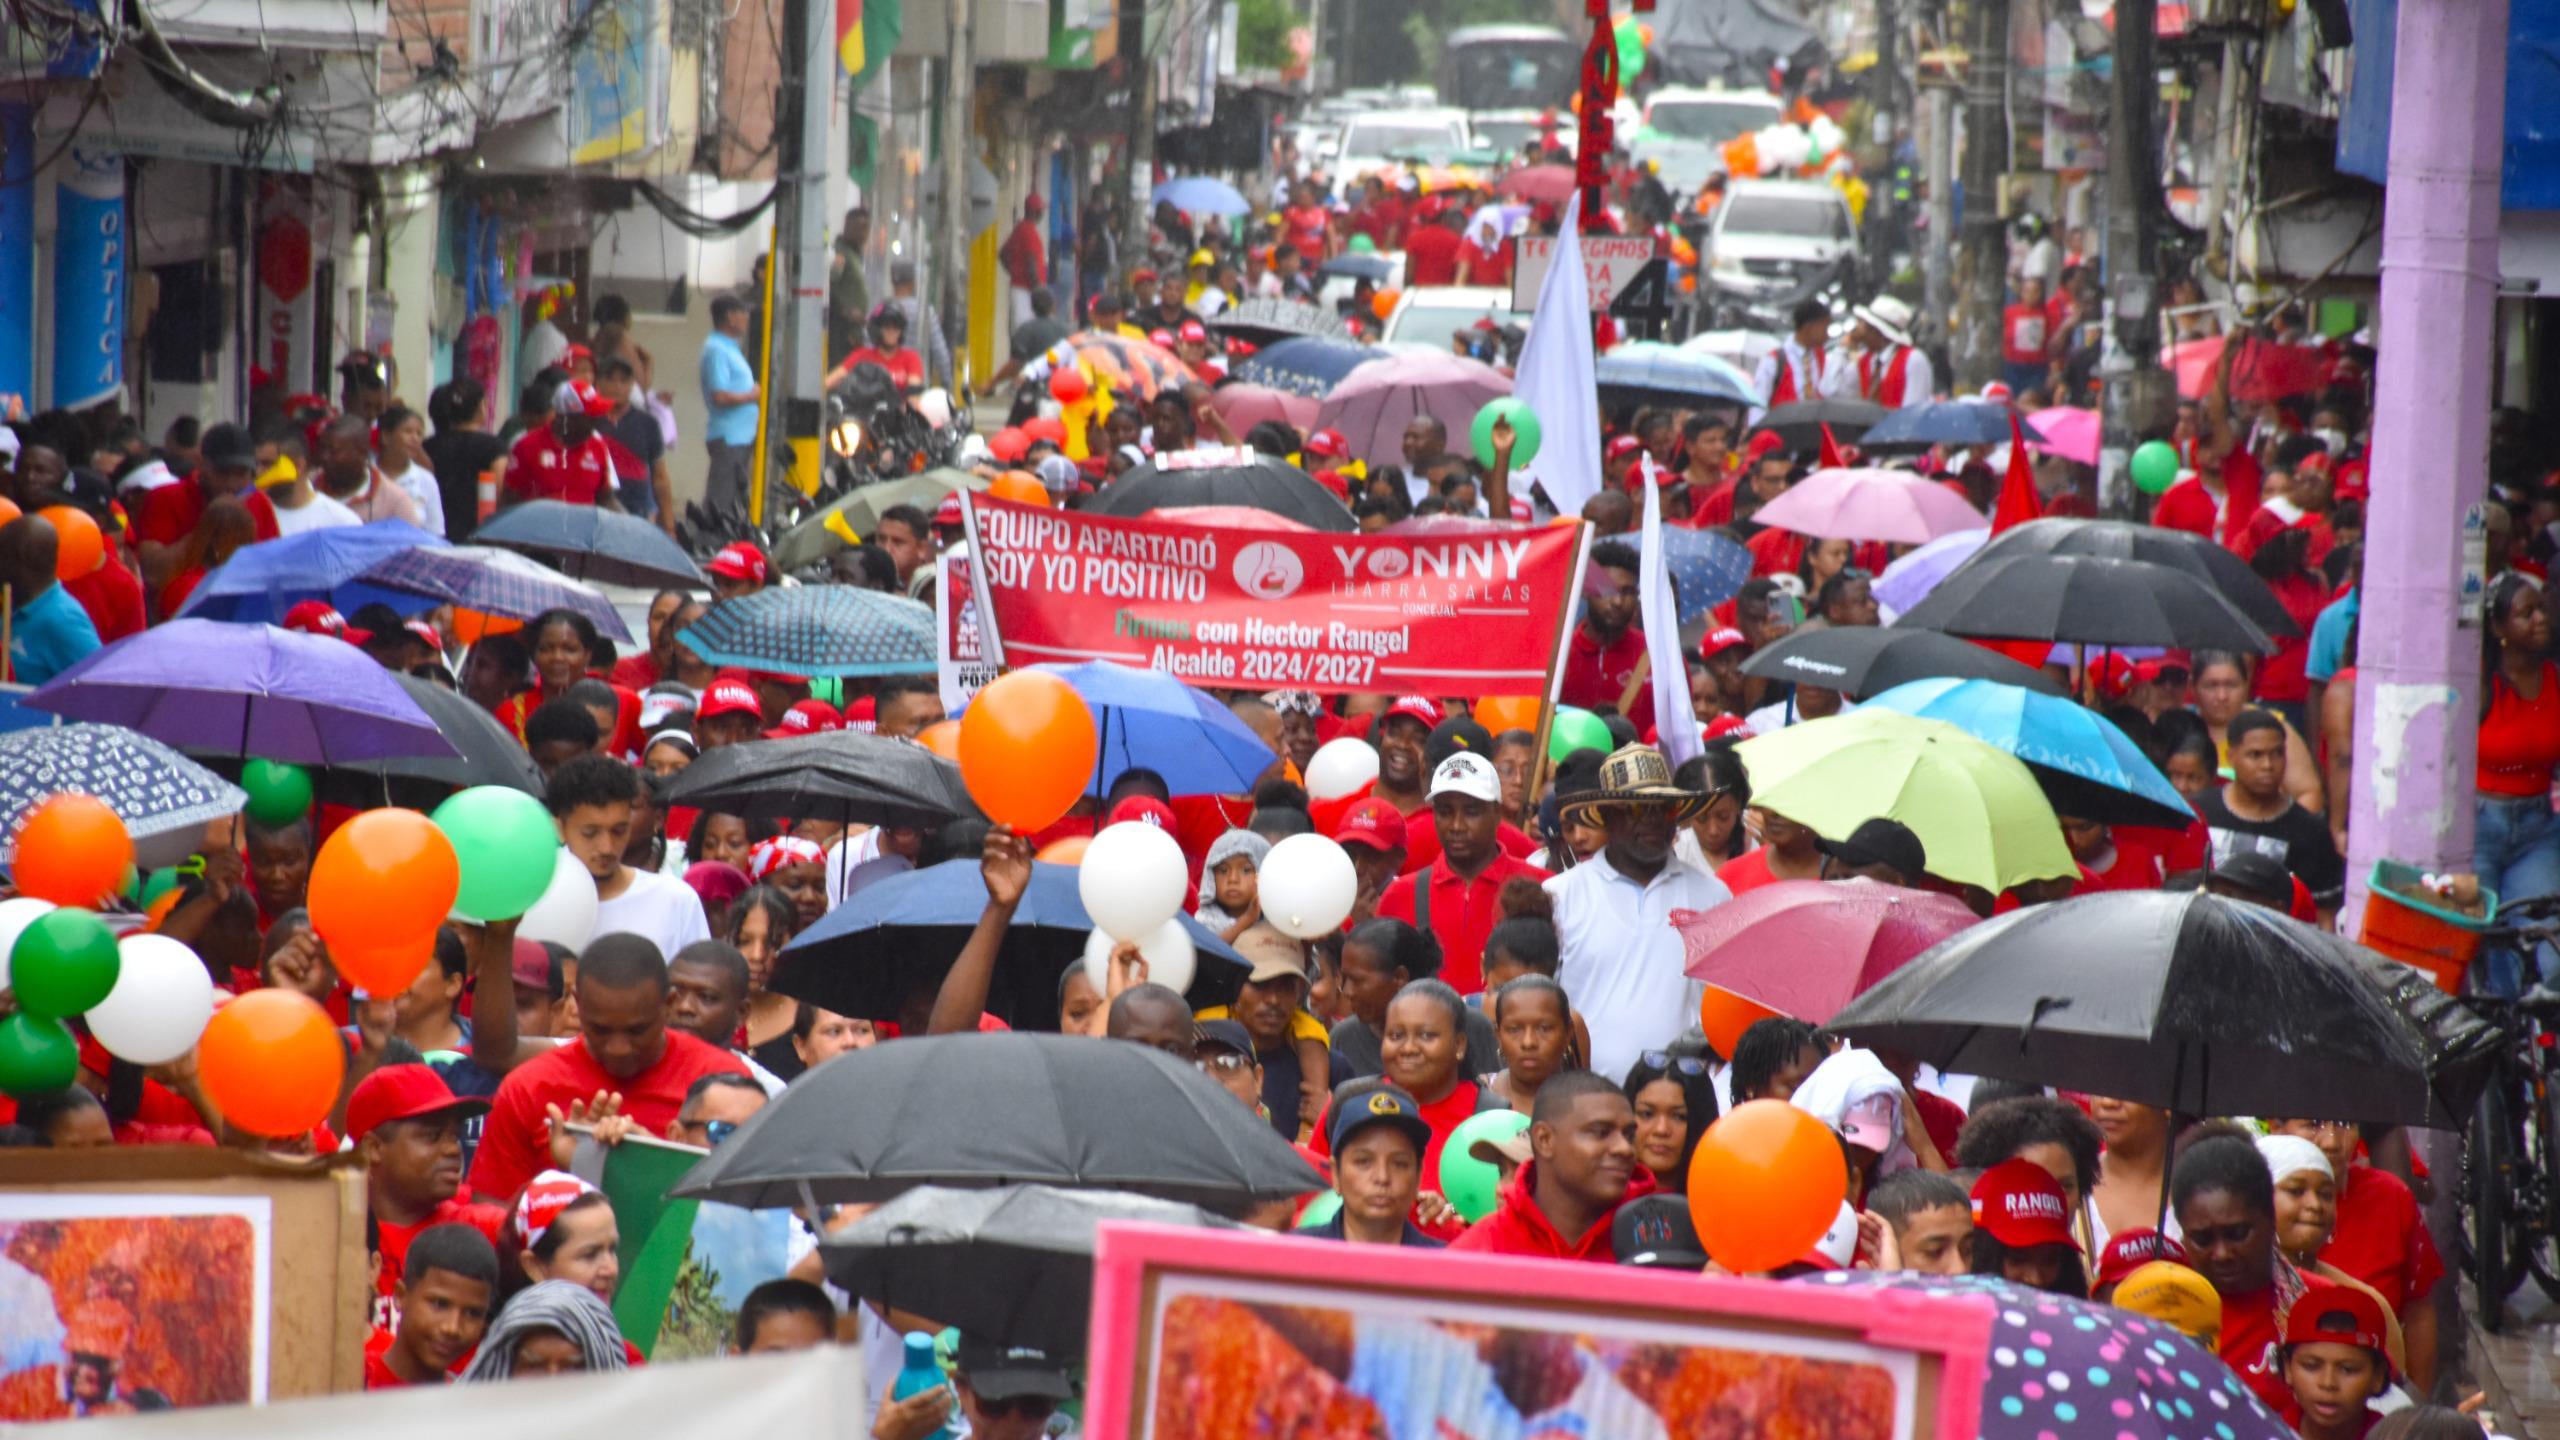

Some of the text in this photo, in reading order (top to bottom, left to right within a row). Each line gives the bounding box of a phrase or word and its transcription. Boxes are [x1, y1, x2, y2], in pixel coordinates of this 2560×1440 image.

[97, 209, 119, 384] OPTICA
[1609, 257, 1674, 339] 4
[976, 507, 1217, 571] EQUIPO APARTADÓ
[983, 547, 1207, 603] SOY YO POSITIVO
[1330, 582, 1531, 603] IBARRA SALAS
[1114, 608, 1410, 657] Firmes con Hector Rangel
[1402, 603, 1458, 617] CONCEJAL
[1151, 643, 1376, 687] Alcalde 2024/2027
[2005, 1192, 2065, 1214] RANGEL
